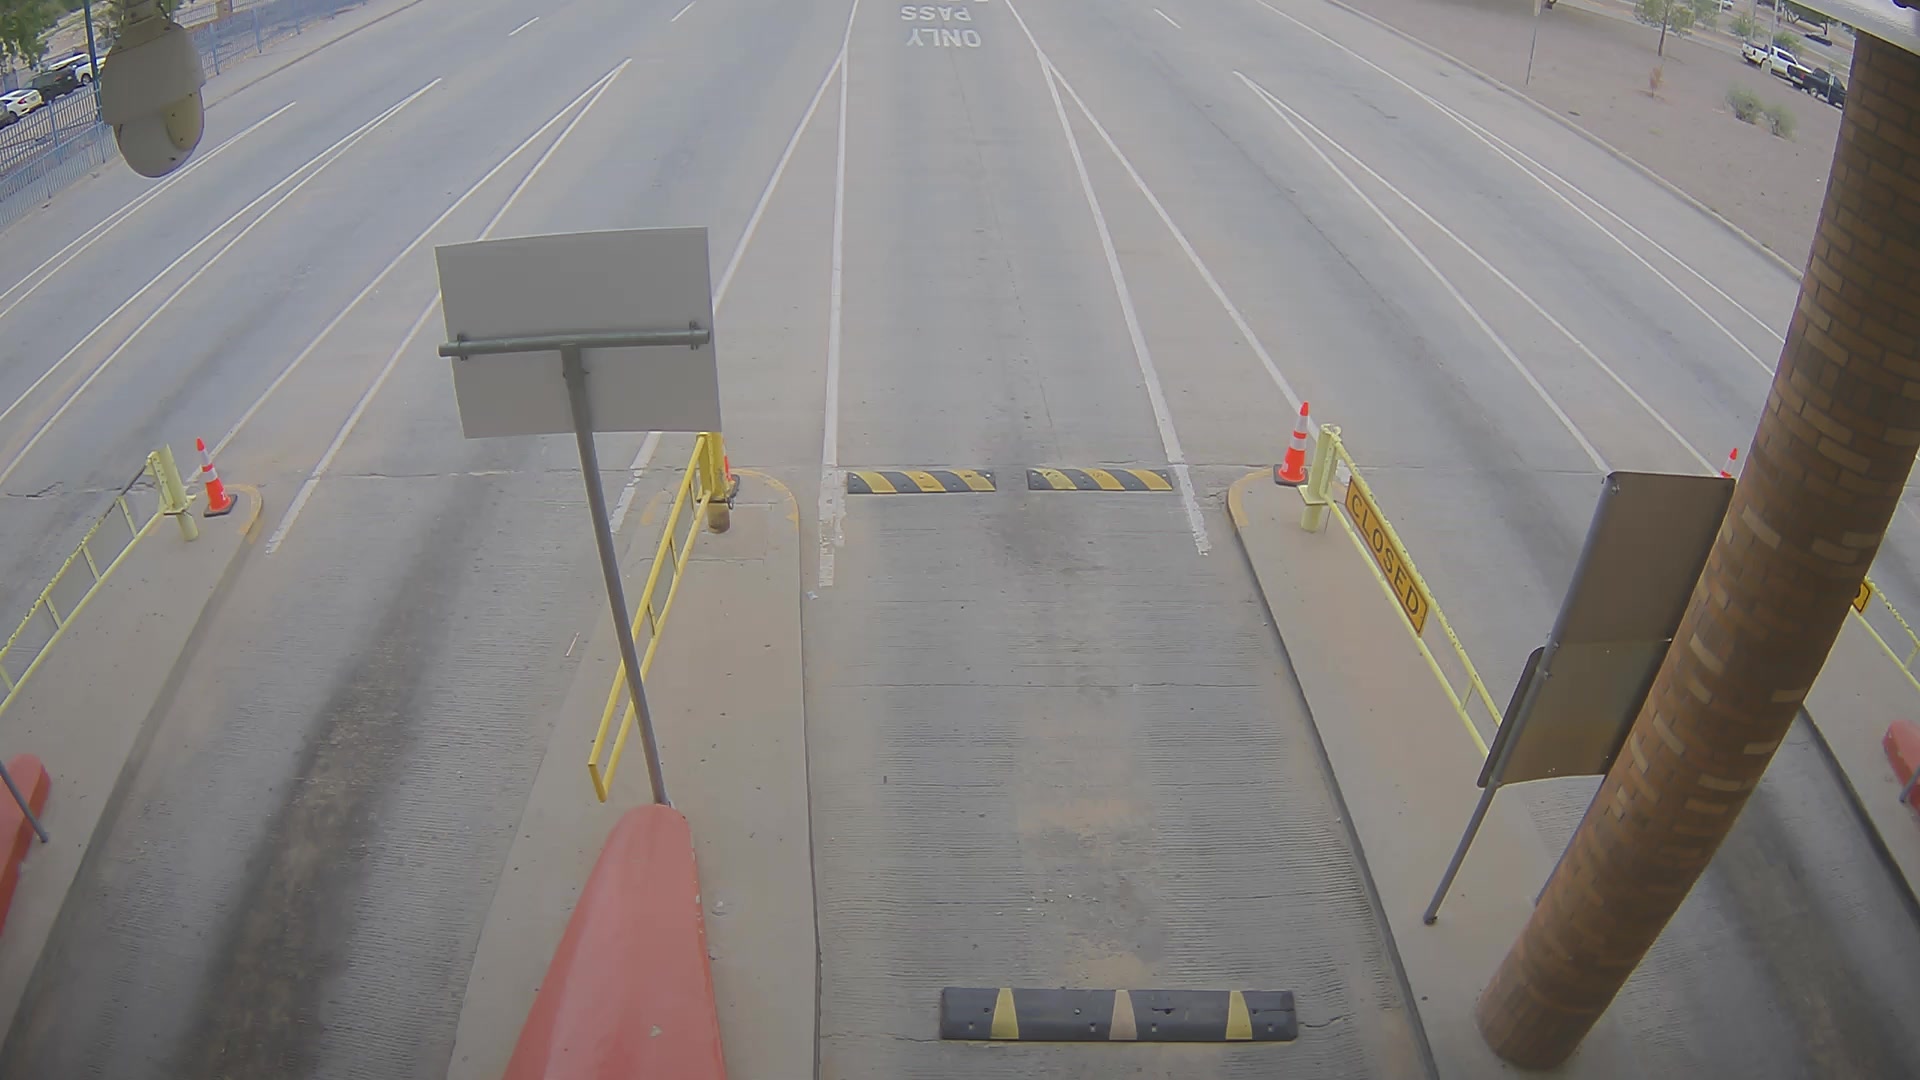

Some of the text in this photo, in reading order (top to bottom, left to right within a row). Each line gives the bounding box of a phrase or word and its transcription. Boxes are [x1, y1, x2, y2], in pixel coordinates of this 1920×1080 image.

[901, 6, 972, 21] PASS
[906, 28, 982, 47] ONLY
[1351, 494, 1419, 615] CLOSED
